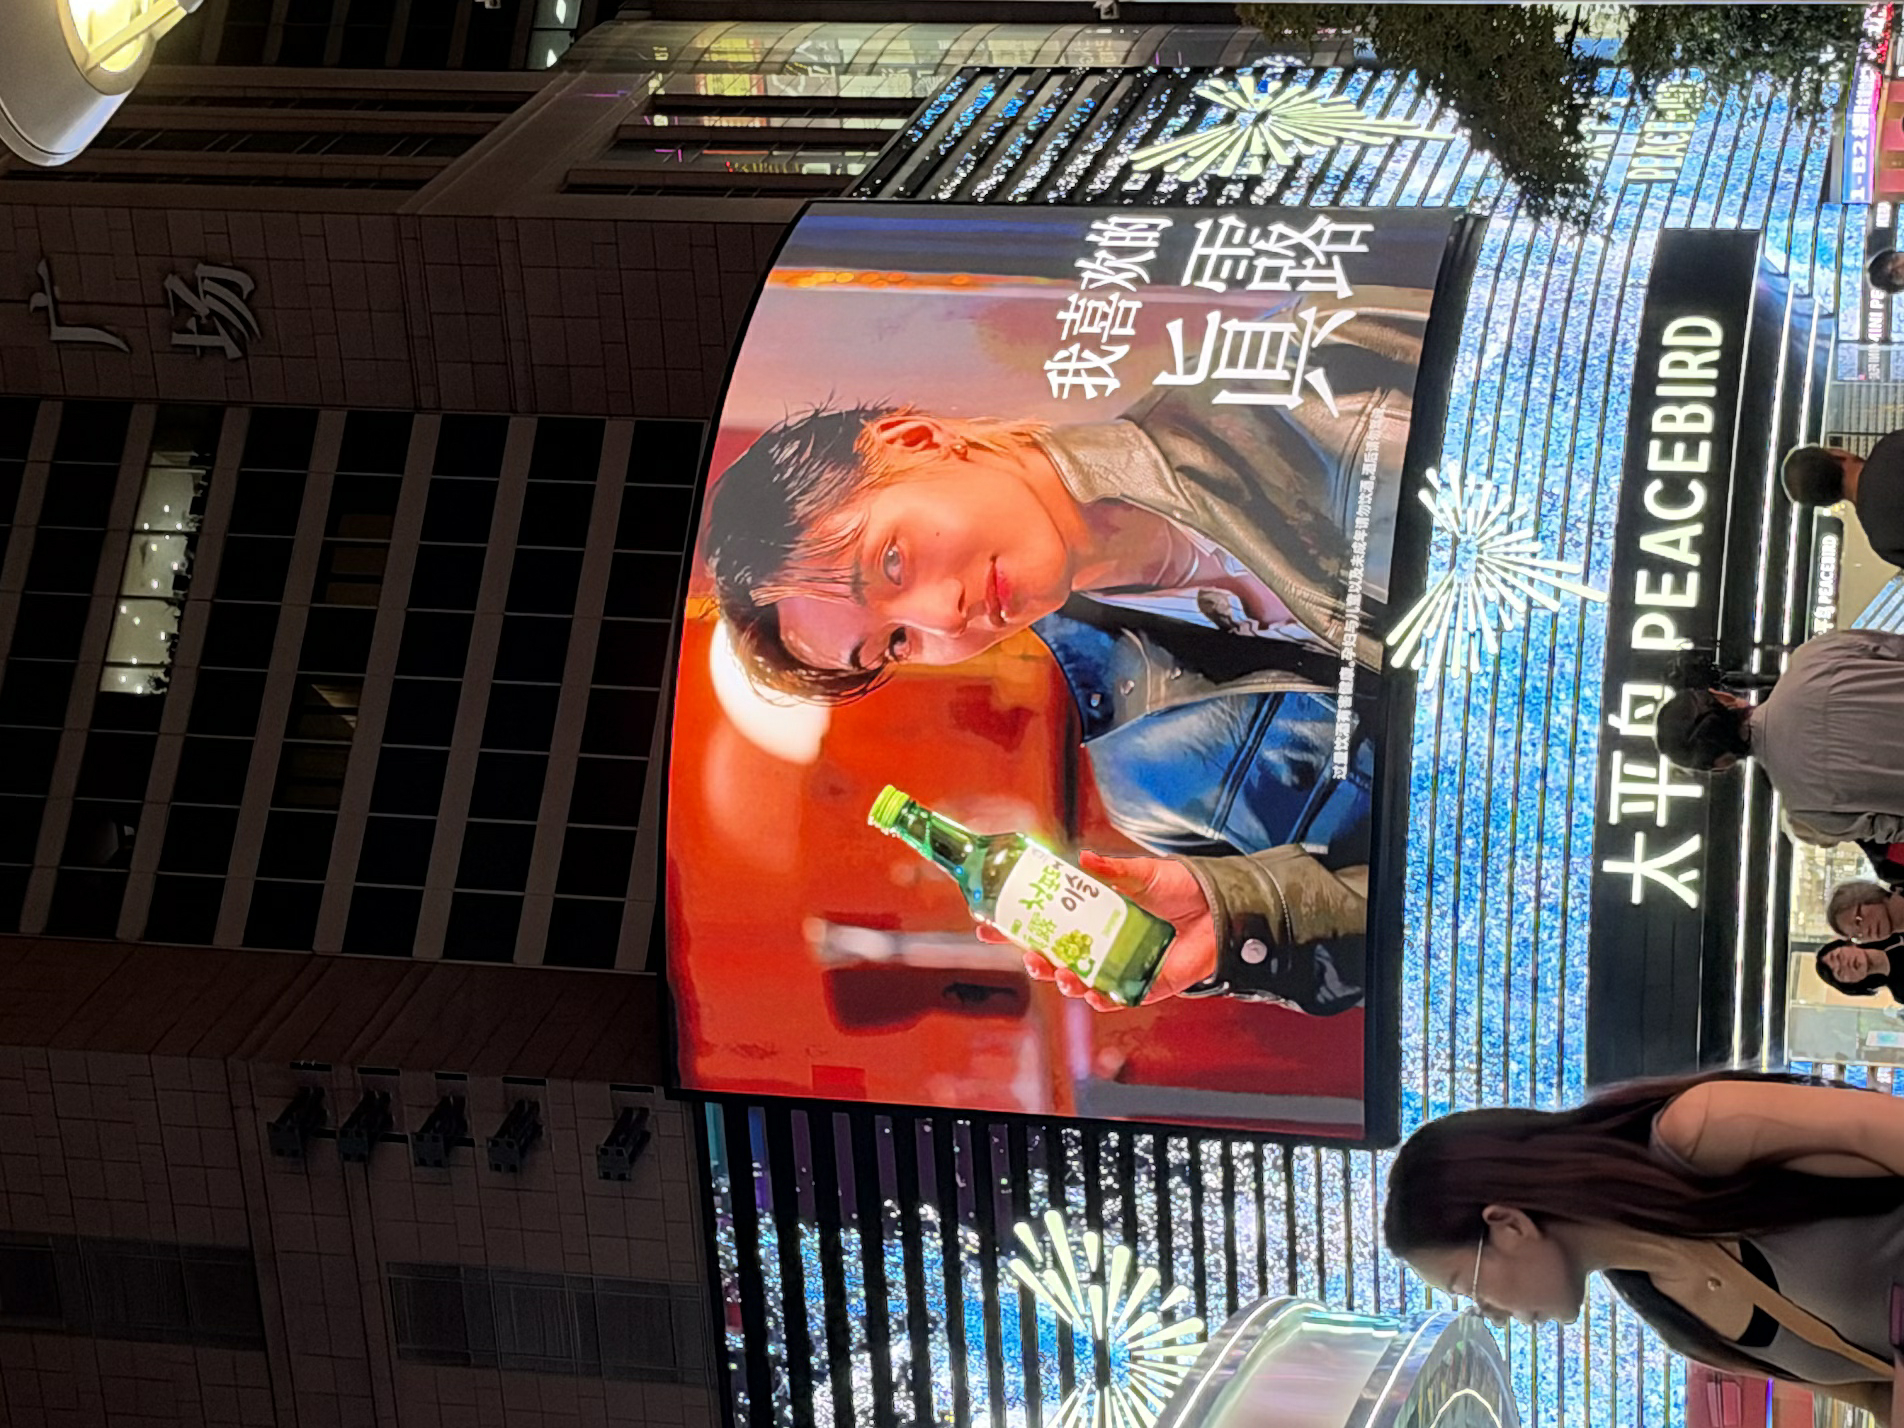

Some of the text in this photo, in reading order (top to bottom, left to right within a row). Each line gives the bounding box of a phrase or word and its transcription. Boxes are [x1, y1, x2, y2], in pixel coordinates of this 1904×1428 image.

[1043, 213, 1174, 400] 我喜欢的
[1602, 314, 1724, 910] 太平鸟 PEACEBIRD
[1812, 534, 1837, 636] 平鸟 PEACEBIRD
